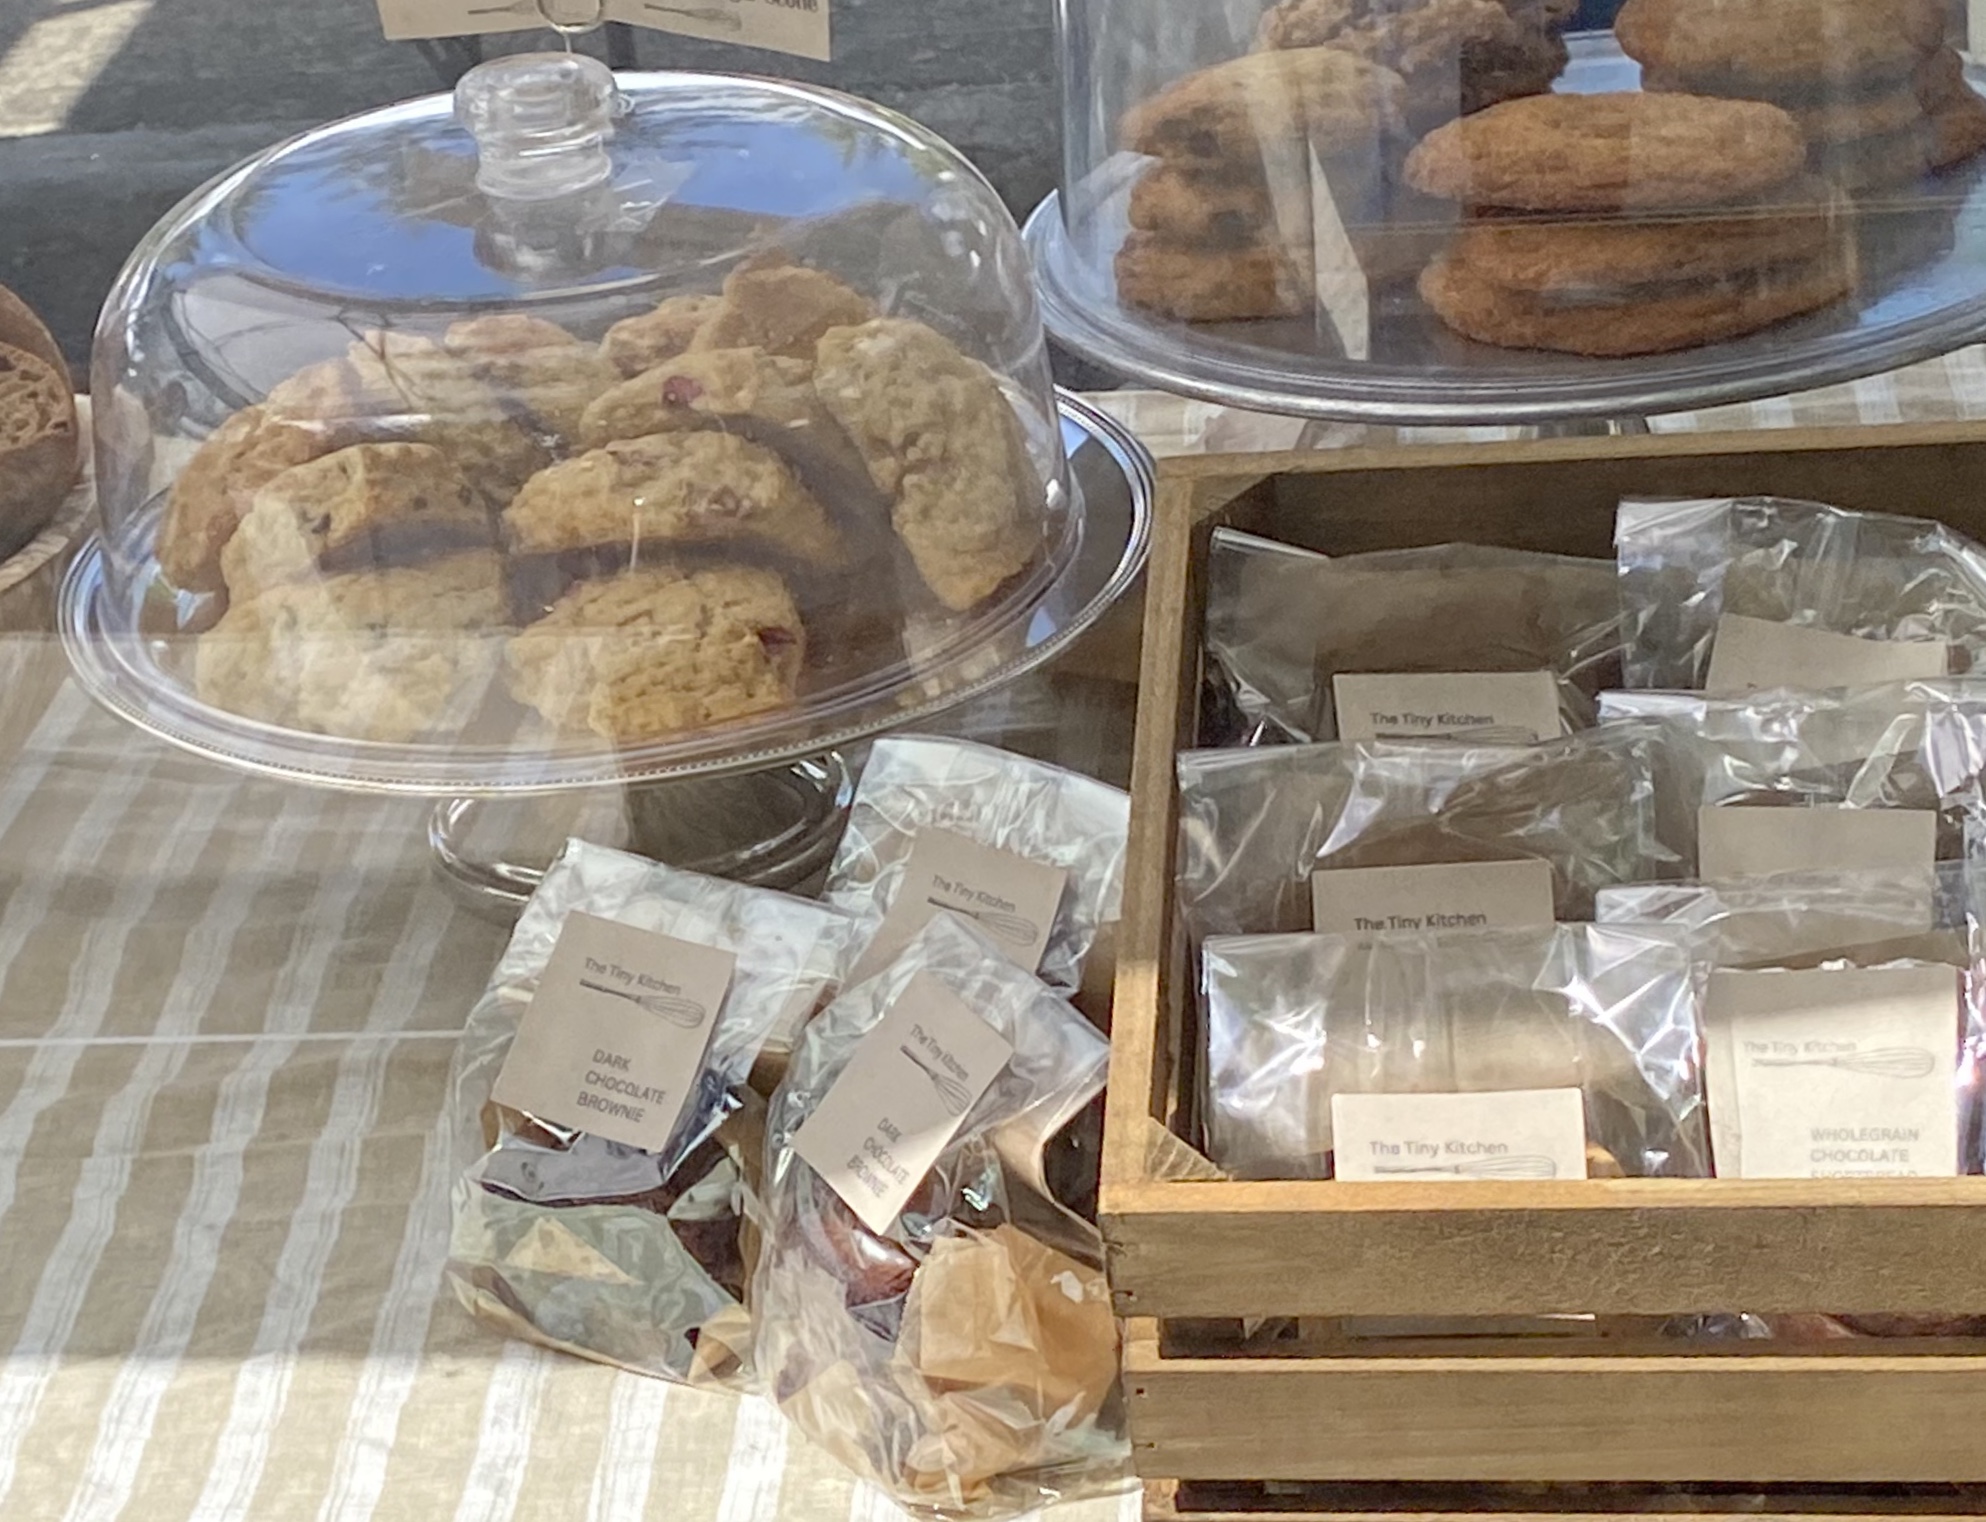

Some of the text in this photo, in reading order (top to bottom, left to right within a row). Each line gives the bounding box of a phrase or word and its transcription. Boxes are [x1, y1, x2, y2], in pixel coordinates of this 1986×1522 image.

[1370, 712, 1495, 727] The Tiny Kitchen
[933, 874, 1017, 912] The Tiny Kitchen
[1354, 912, 1487, 931] The Tiny Kitchen
[585, 957, 682, 995] The Tiny Kitchen
[592, 1049, 632, 1071] DARK
[910, 1023, 971, 1081] The Tiny Kitchen
[1742, 1041, 1857, 1055] The Tiny Kitchen
[585, 1071, 667, 1104] CHOCOLATE
[577, 1091, 646, 1122] BROWNIE
[876, 1117, 904, 1143] DARK
[1810, 1127, 1920, 1141] WHOLEGRAIN
[863, 1137, 911, 1185] CHOCOLATE
[1369, 1140, 1509, 1158] The Tiny Kitchen
[1810, 1149, 1910, 1163] CHOCOLATE
[846, 1155, 890, 1198] BROWNIE
